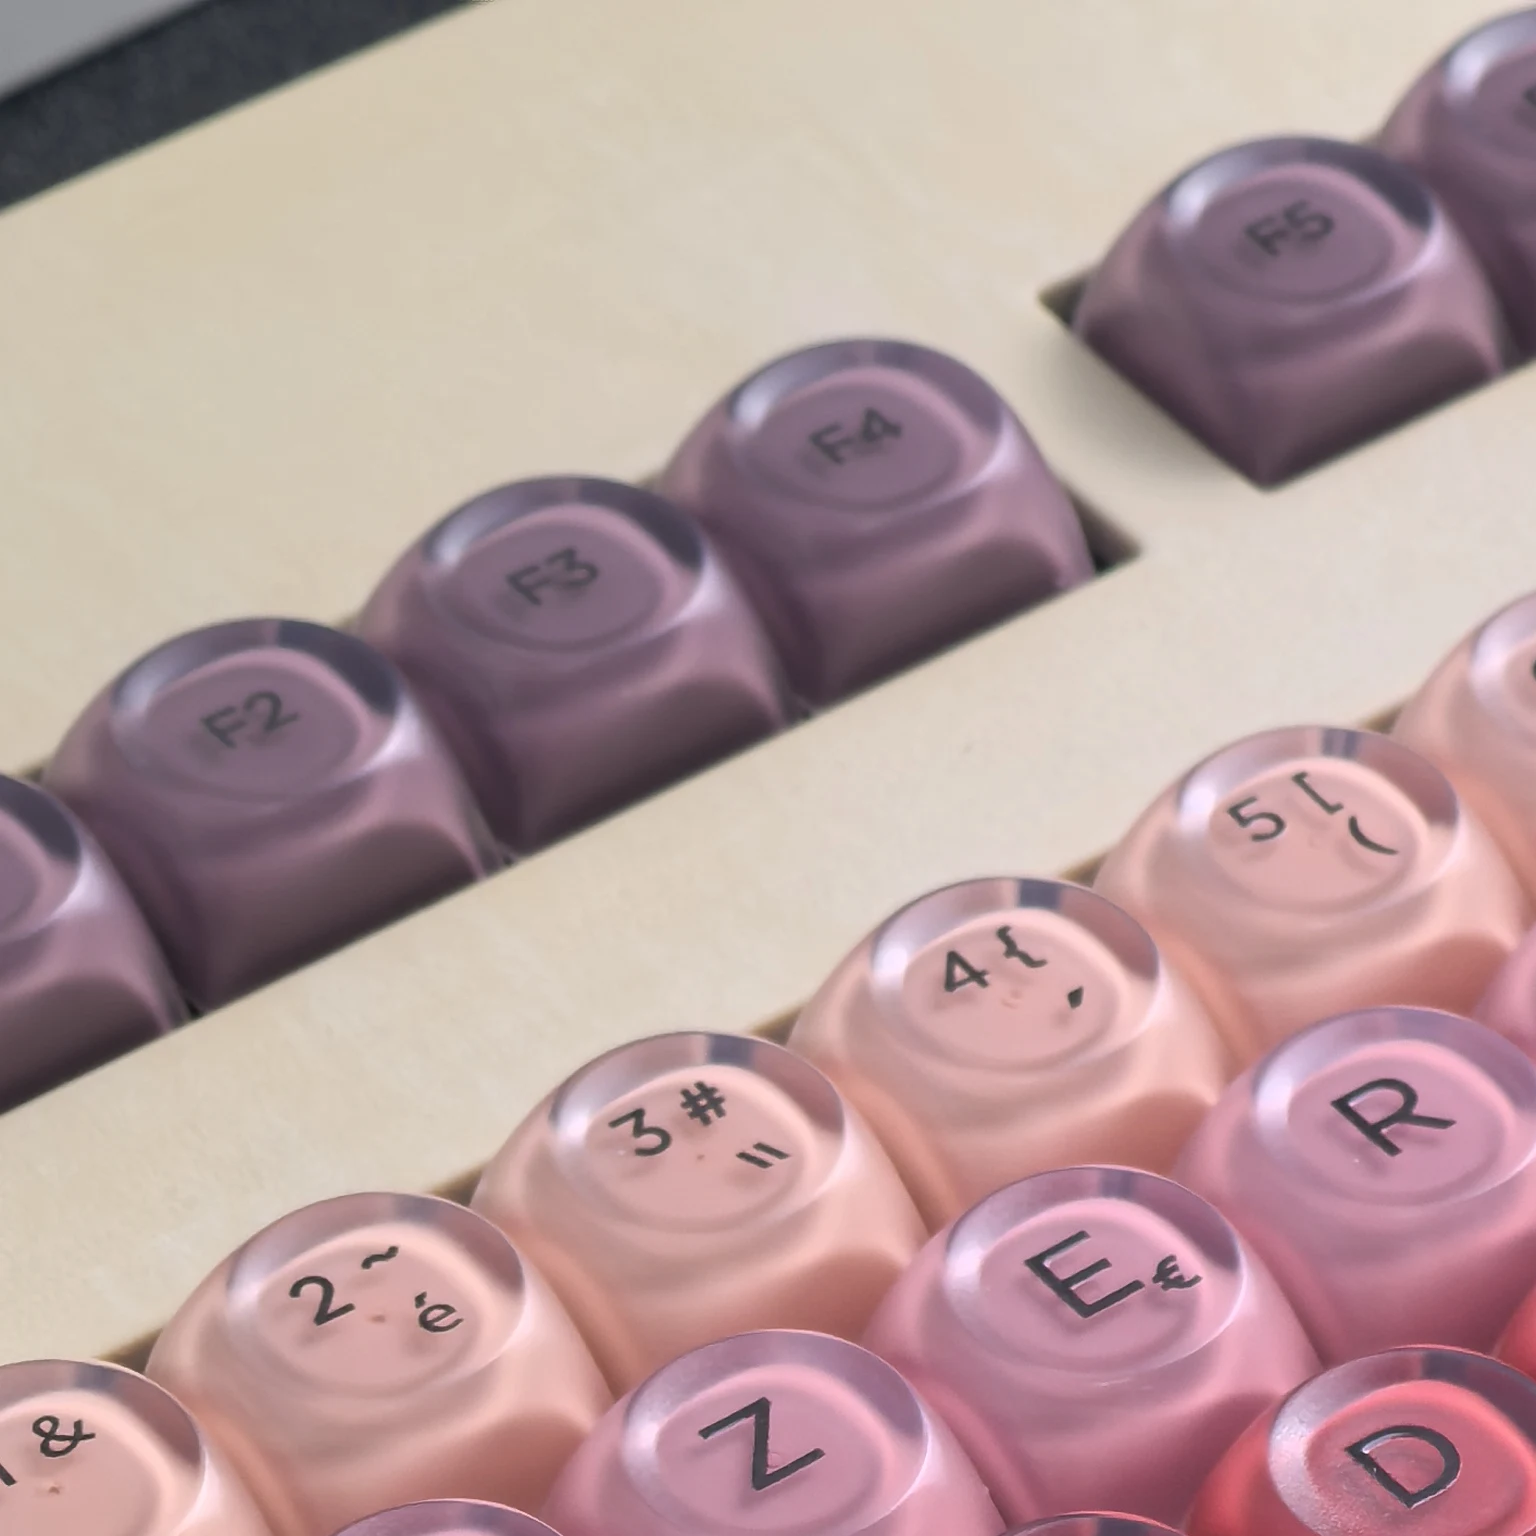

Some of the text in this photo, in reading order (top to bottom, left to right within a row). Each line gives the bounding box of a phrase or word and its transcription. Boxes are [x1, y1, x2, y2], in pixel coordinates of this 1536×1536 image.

[1243, 199, 1335, 257] F5
[808, 406, 903, 467] F4
[505, 546, 600, 607] F3
[205, 688, 298, 750] F2
[1227, 796, 1287, 842] 5
[942, 949, 990, 994] 4
[608, 1081, 727, 1157] 3 #
[1328, 1076, 1457, 1158] R
[288, 1274, 356, 1327] 2
[1022, 1228, 1203, 1320] E €
[414, 1290, 465, 1334] é
[31, 1414, 96, 1458] &
[698, 1396, 822, 1493] Z
[1344, 1424, 1462, 1510] D
